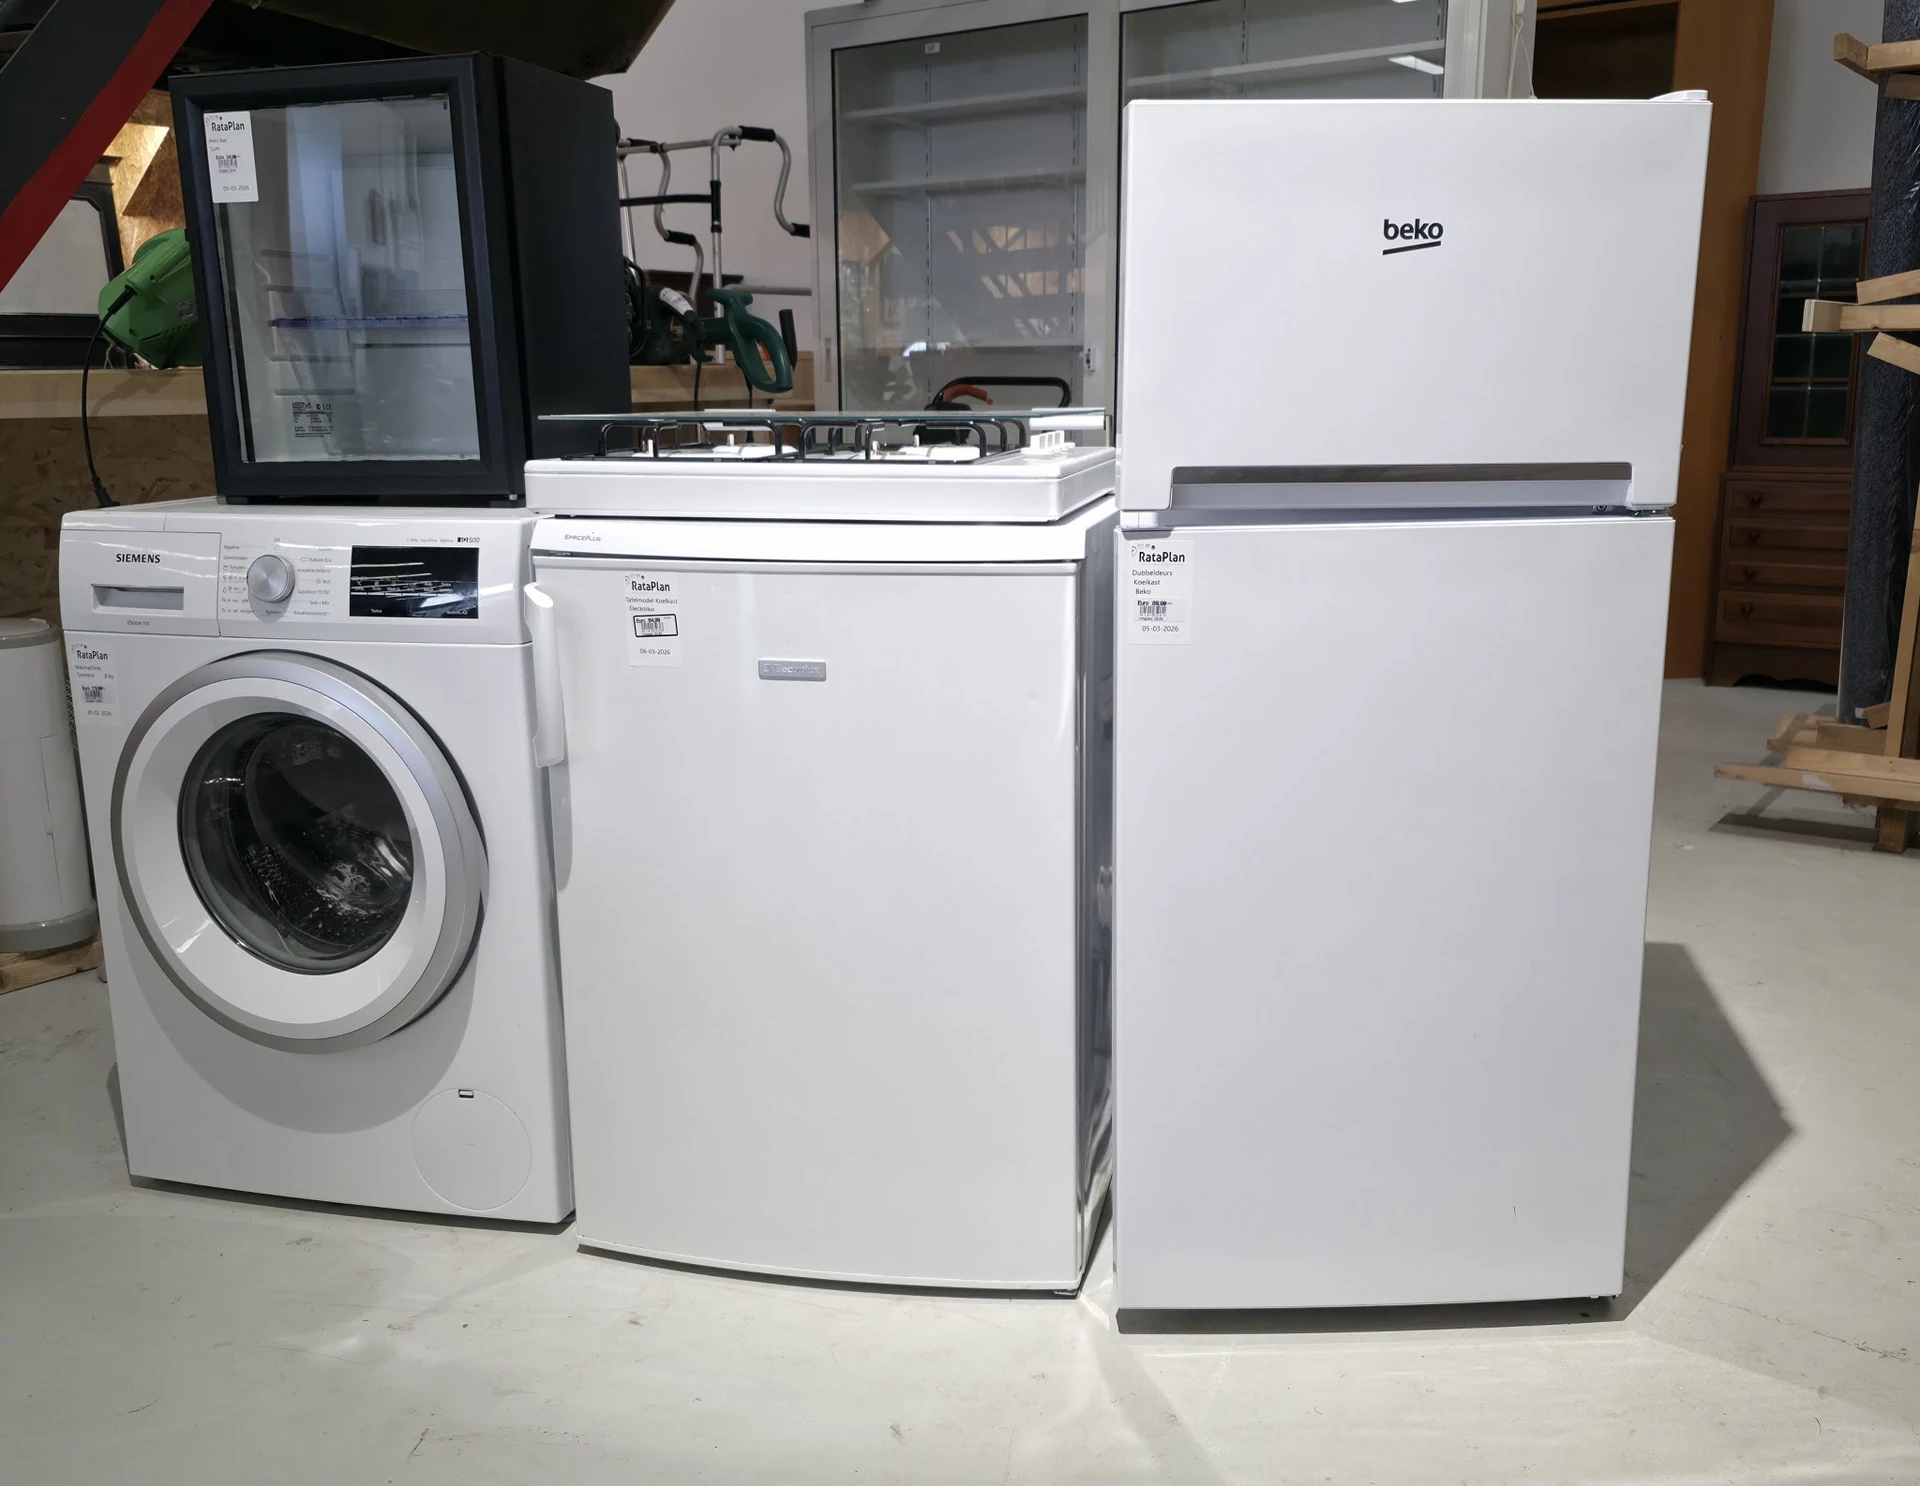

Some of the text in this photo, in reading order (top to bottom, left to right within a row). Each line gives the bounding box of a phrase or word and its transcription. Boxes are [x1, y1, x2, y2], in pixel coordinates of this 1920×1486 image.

[211, 122, 245, 132] RataPlan
[1383, 218, 1444, 241] beko
[115, 553, 161, 564] SIEMENS
[1138, 551, 1186, 563] RataPlan
[1131, 569, 1173, 577] Dubbeldeurs
[631, 581, 670, 591] RataPlan
[625, 596, 655, 604] Tafelmodel
[1141, 625, 1180, 633] 05-03-2026
[77, 650, 108, 660] RataPlan
